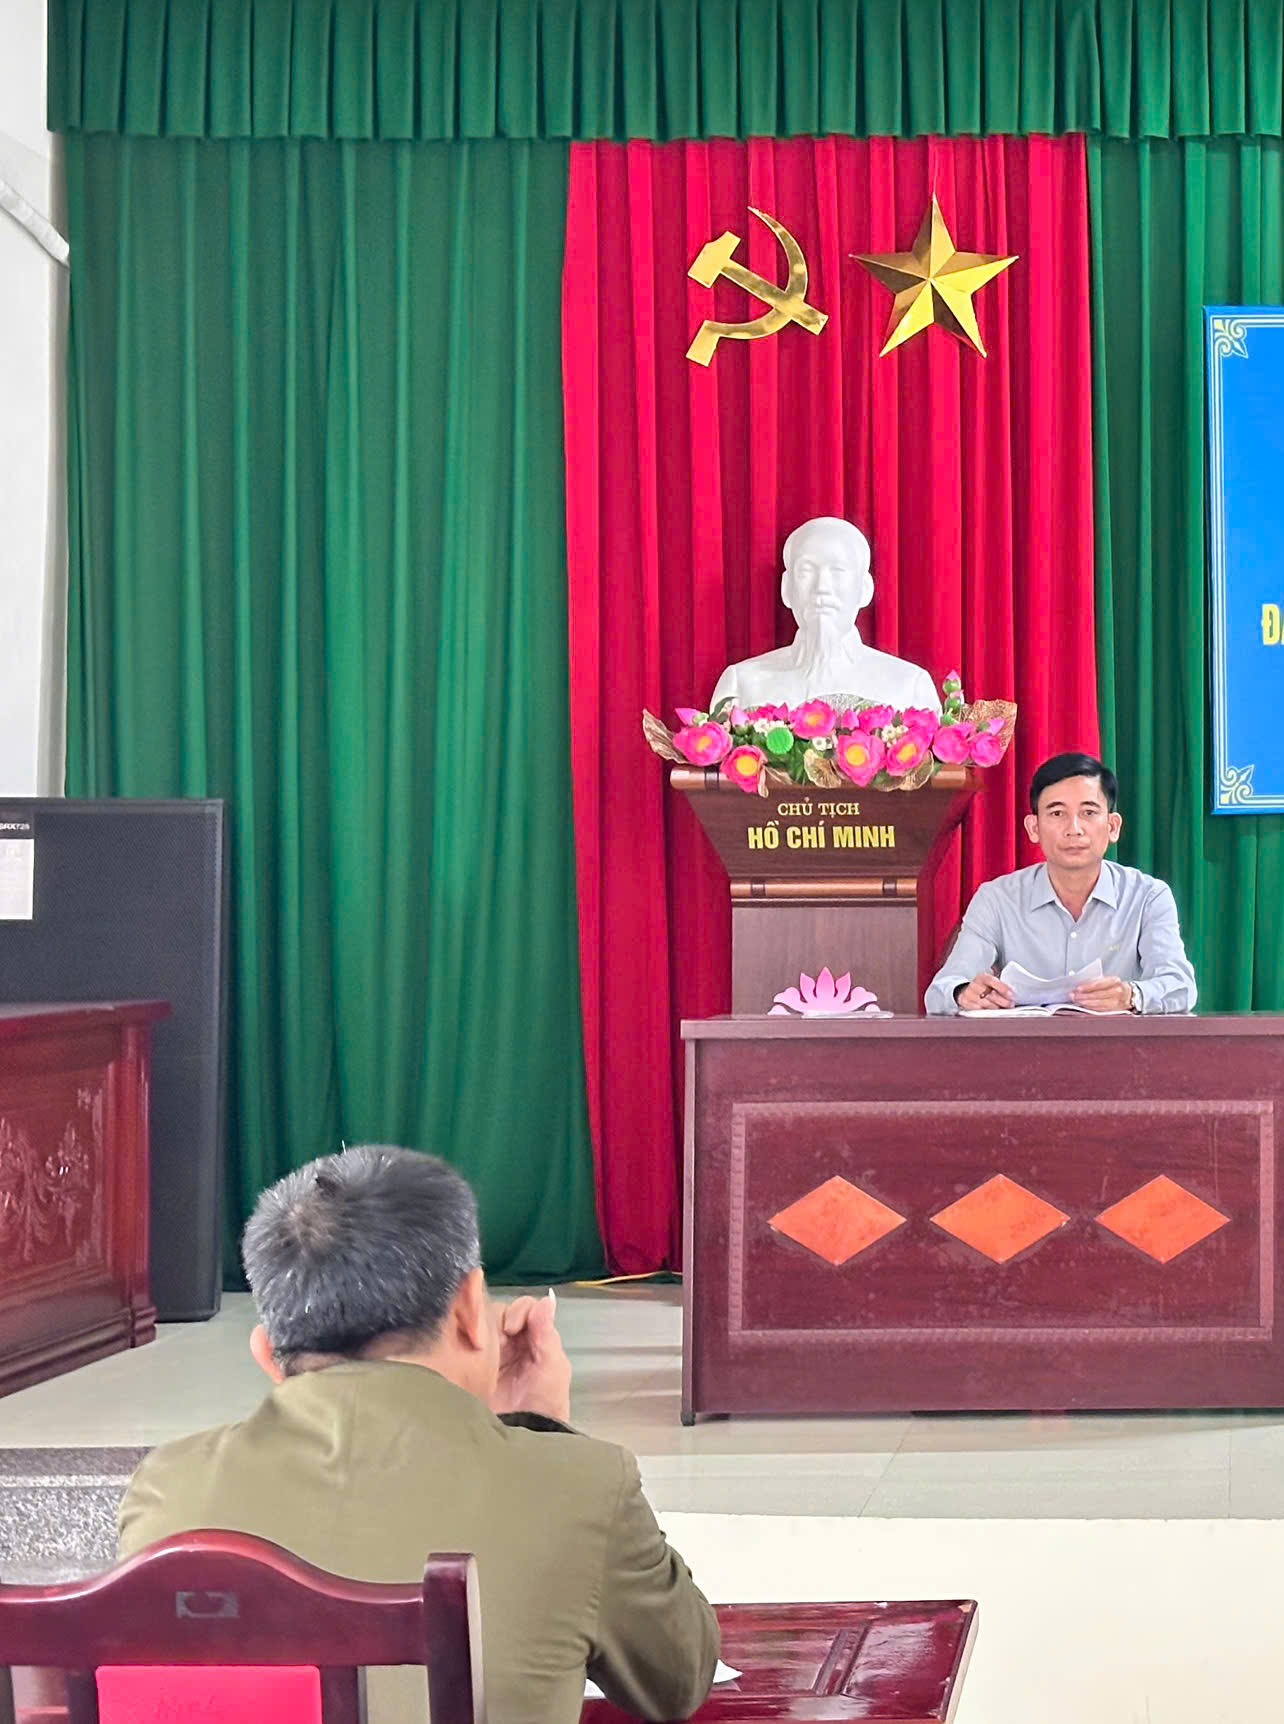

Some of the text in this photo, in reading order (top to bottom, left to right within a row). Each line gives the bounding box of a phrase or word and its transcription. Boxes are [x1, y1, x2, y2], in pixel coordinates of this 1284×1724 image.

[777, 797, 860, 818] CHỦ TỊCH
[747, 820, 896, 849] HỒ CHÍ MINH
